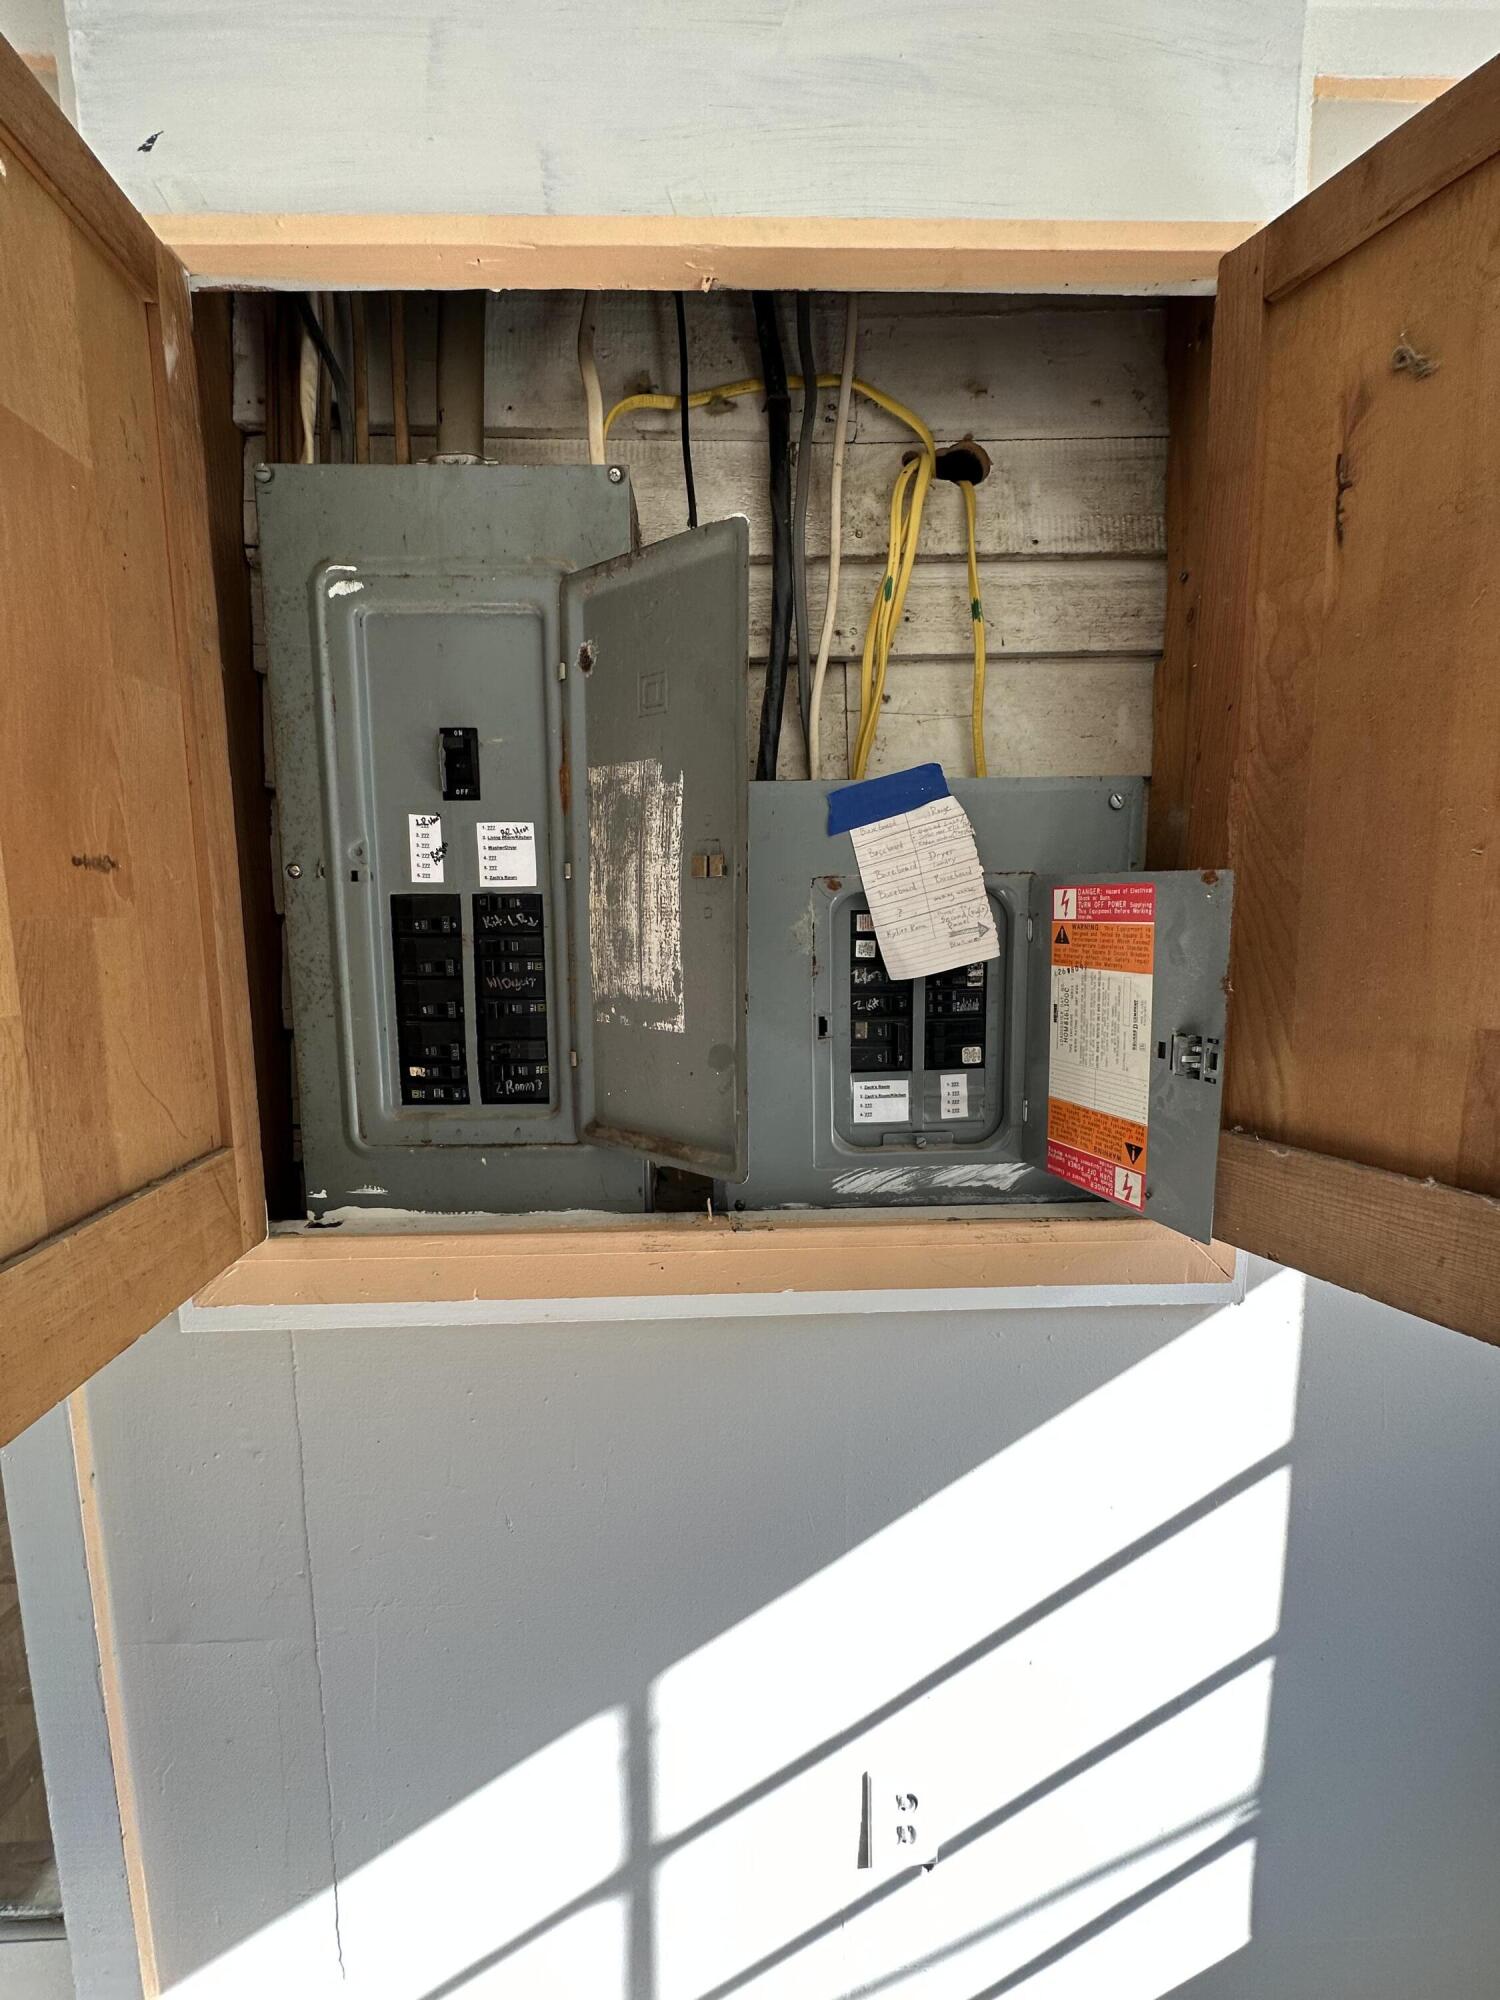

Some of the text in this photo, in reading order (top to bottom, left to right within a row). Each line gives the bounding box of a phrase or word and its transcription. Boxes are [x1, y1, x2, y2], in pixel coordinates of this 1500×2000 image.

[1093, 900, 1105, 908] OFF
[1107, 900, 1127, 908] POWER
[1067, 1161, 1085, 1172] POWER
[1087, 1167, 1097, 1176] OFF
